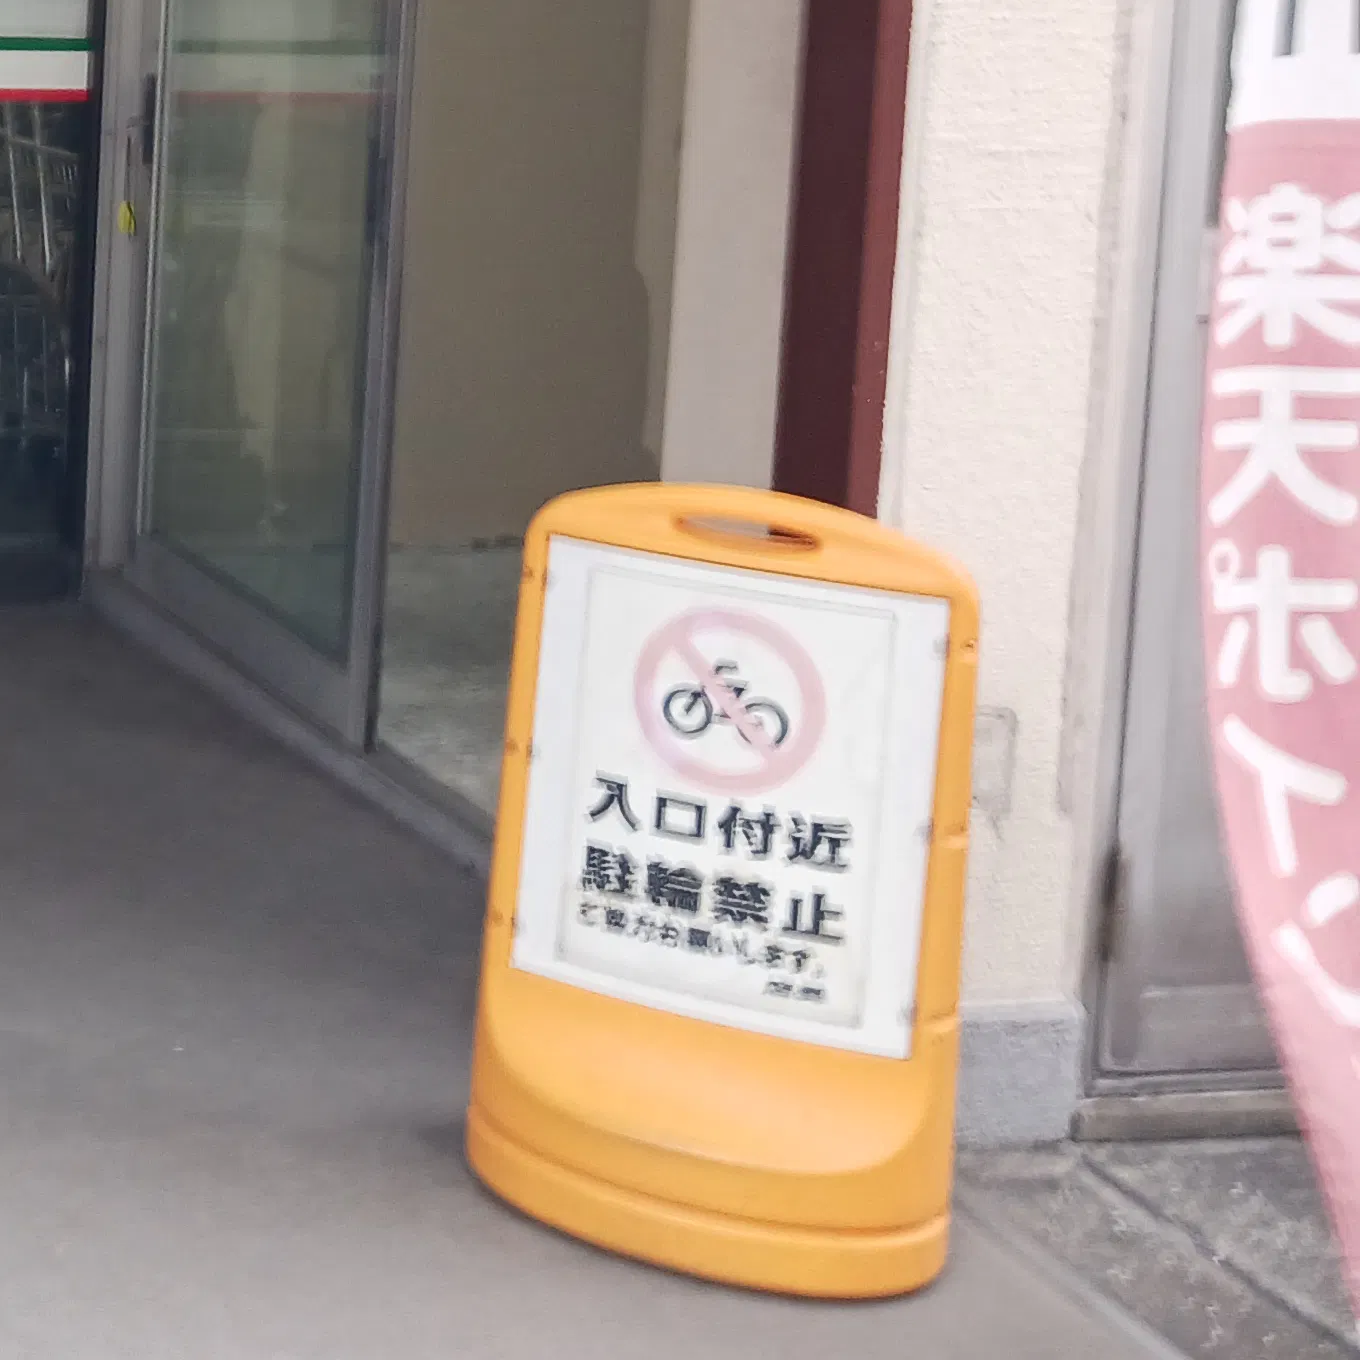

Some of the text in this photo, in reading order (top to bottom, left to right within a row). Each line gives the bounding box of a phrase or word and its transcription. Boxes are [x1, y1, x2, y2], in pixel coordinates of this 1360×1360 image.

[584, 770, 851, 871] 入口付近
[580, 843, 846, 940] 駐輪禁止
